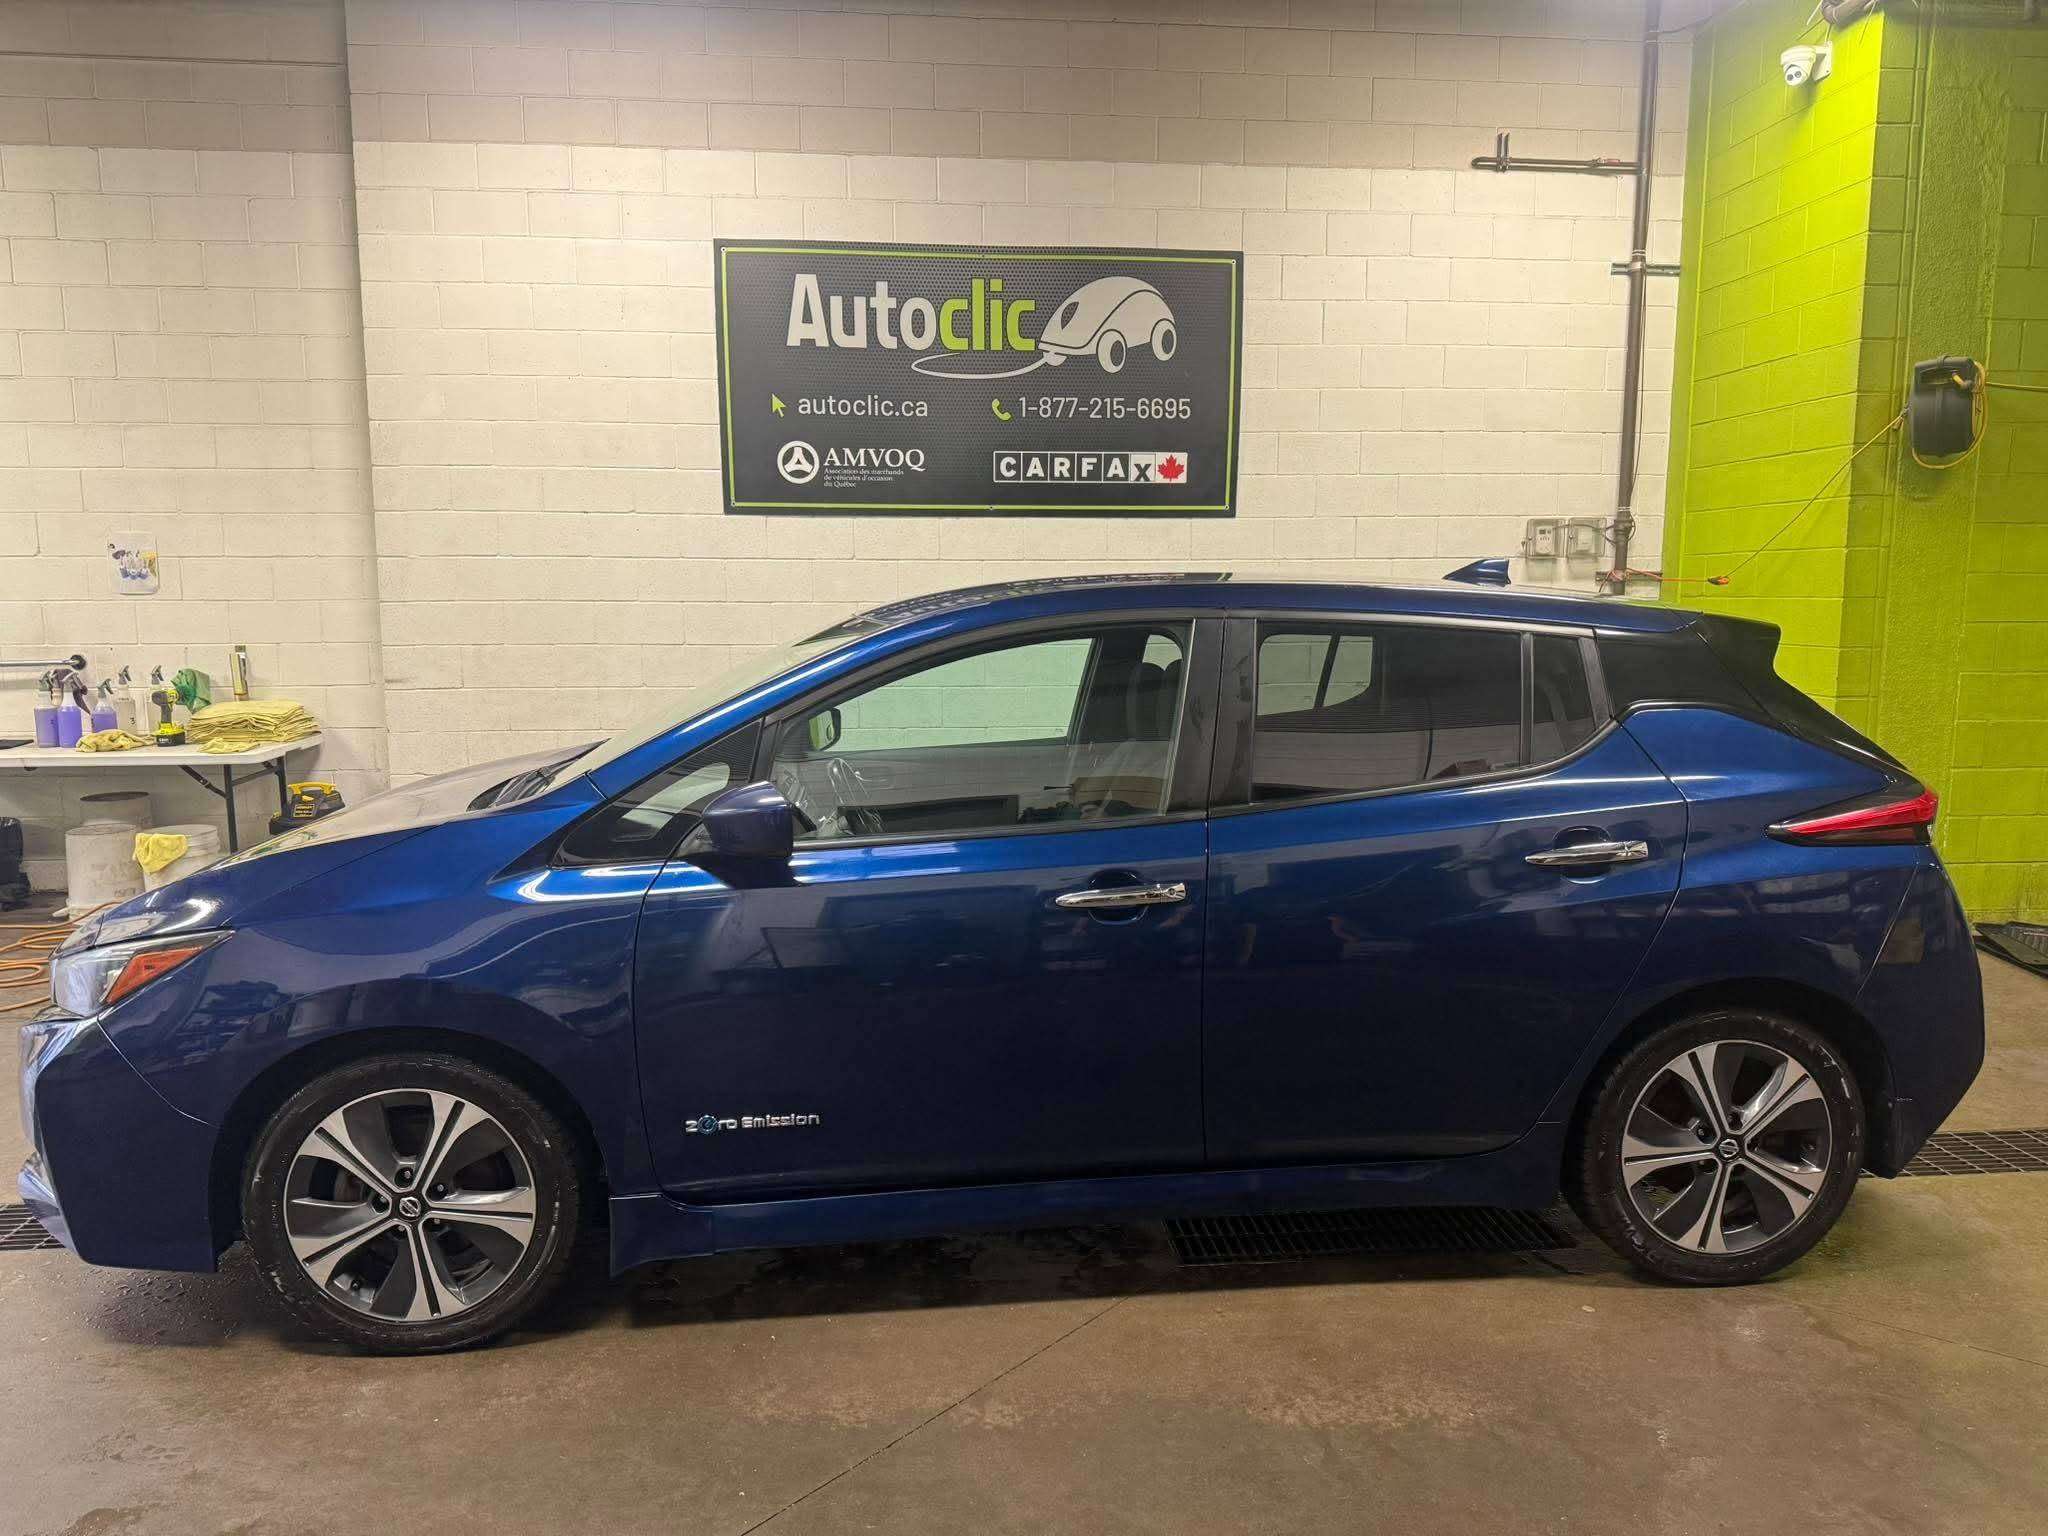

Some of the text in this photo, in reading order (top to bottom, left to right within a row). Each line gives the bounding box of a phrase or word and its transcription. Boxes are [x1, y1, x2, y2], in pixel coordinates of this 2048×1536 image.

[786, 273, 1036, 351] Autoclic
[798, 395, 928, 418] autoclic.ca
[1019, 397, 1191, 419] 1-877-215-6695
[823, 447, 926, 472] AMVOQ
[999, 456, 1151, 482] CARFAX
[741, 1113, 820, 1129] Emission
